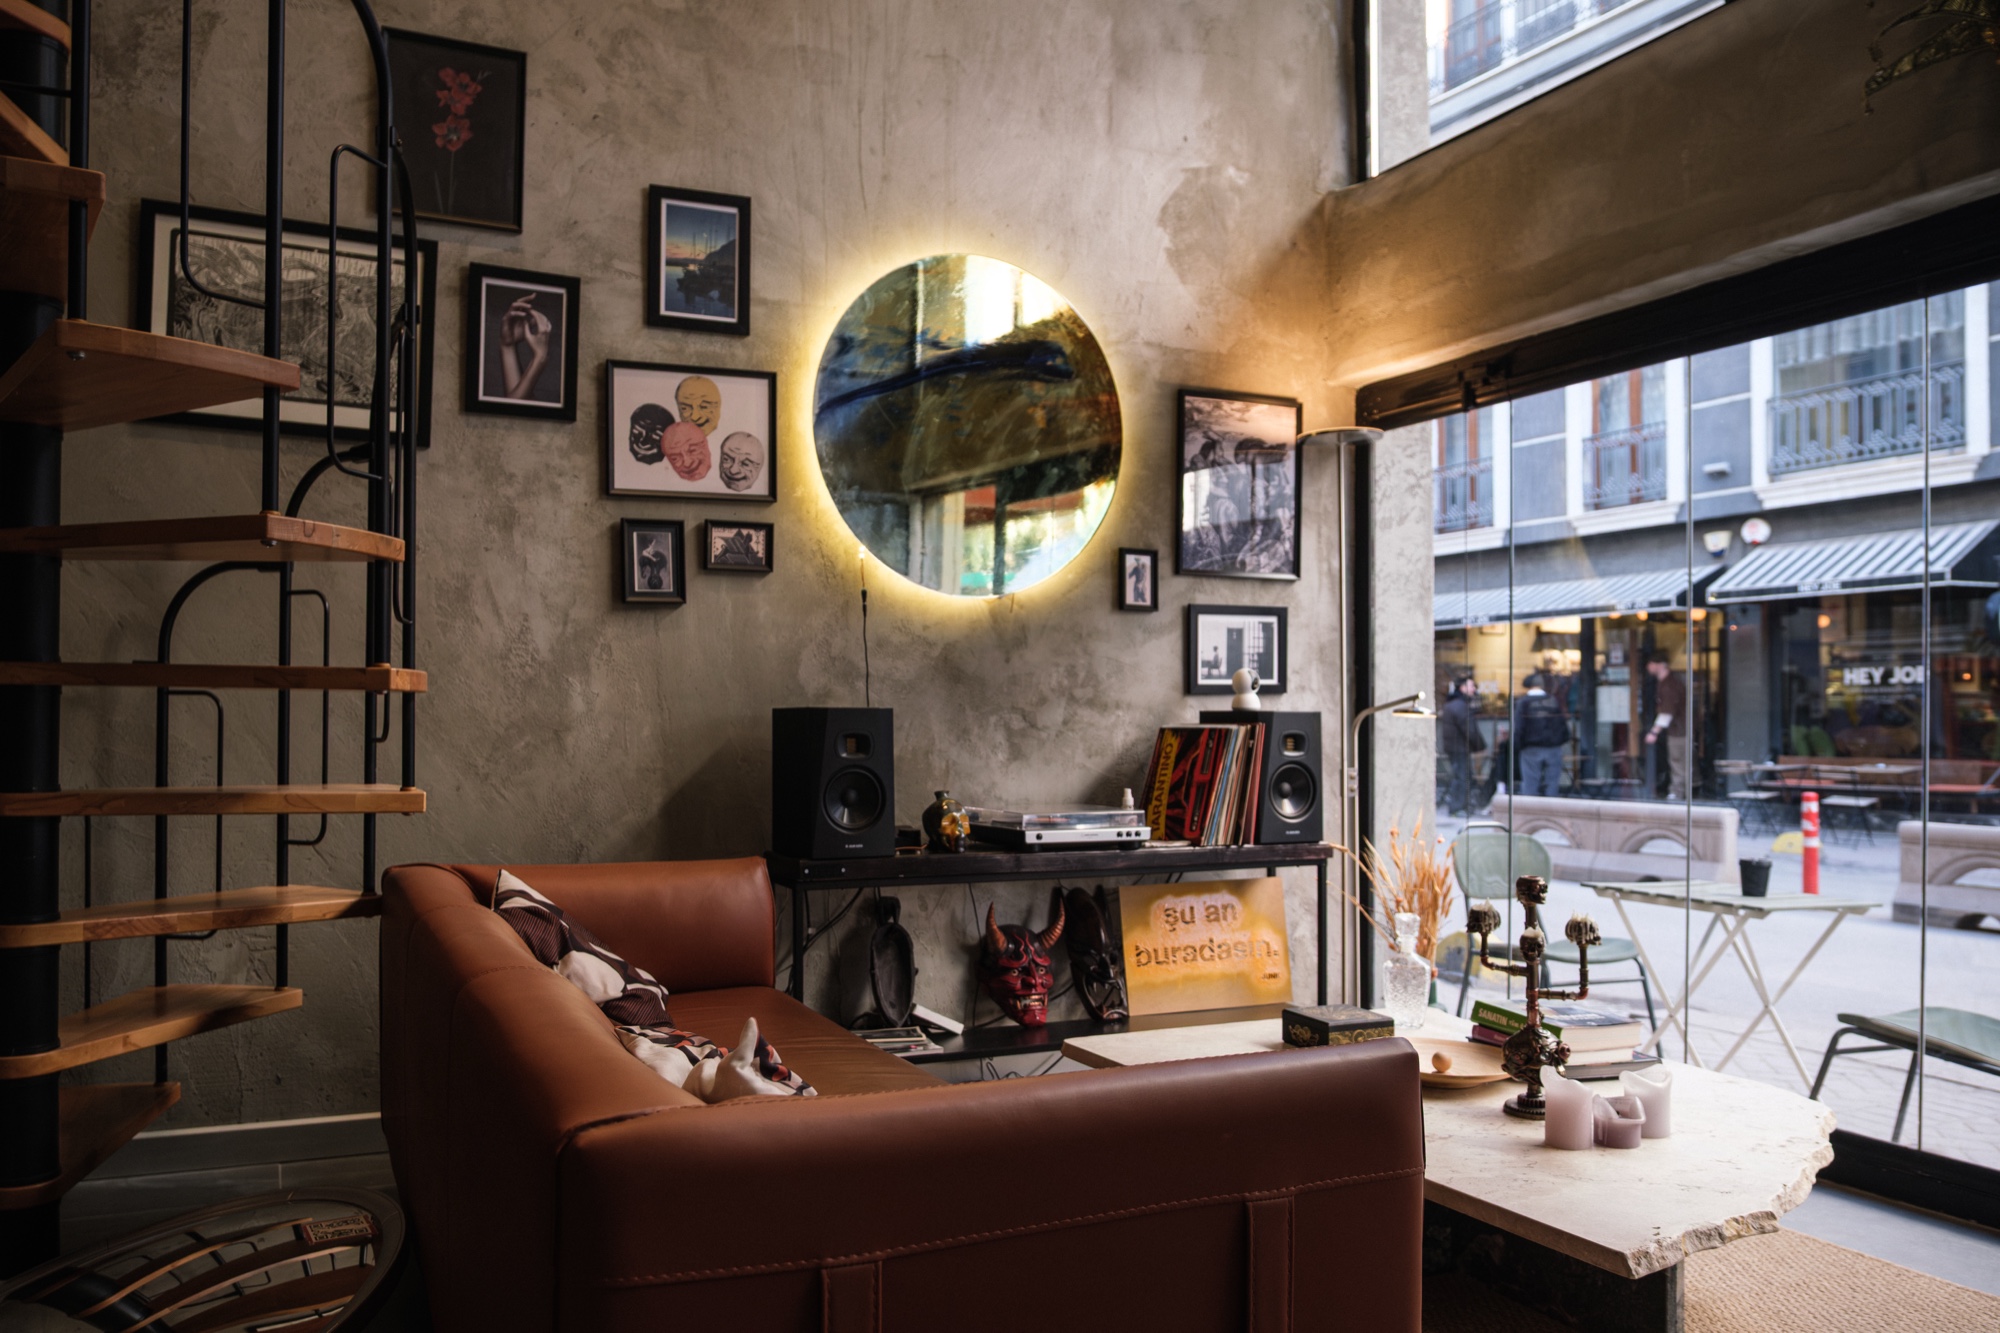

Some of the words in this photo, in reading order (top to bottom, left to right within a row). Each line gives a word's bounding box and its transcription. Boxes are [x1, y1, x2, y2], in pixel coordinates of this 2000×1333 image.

[1843, 666, 1885, 685] HEY
[1151, 742, 1174, 832] TARANTINO
[1205, 901, 1238, 923] an
[1478, 1007, 1508, 1027] SANATIN
